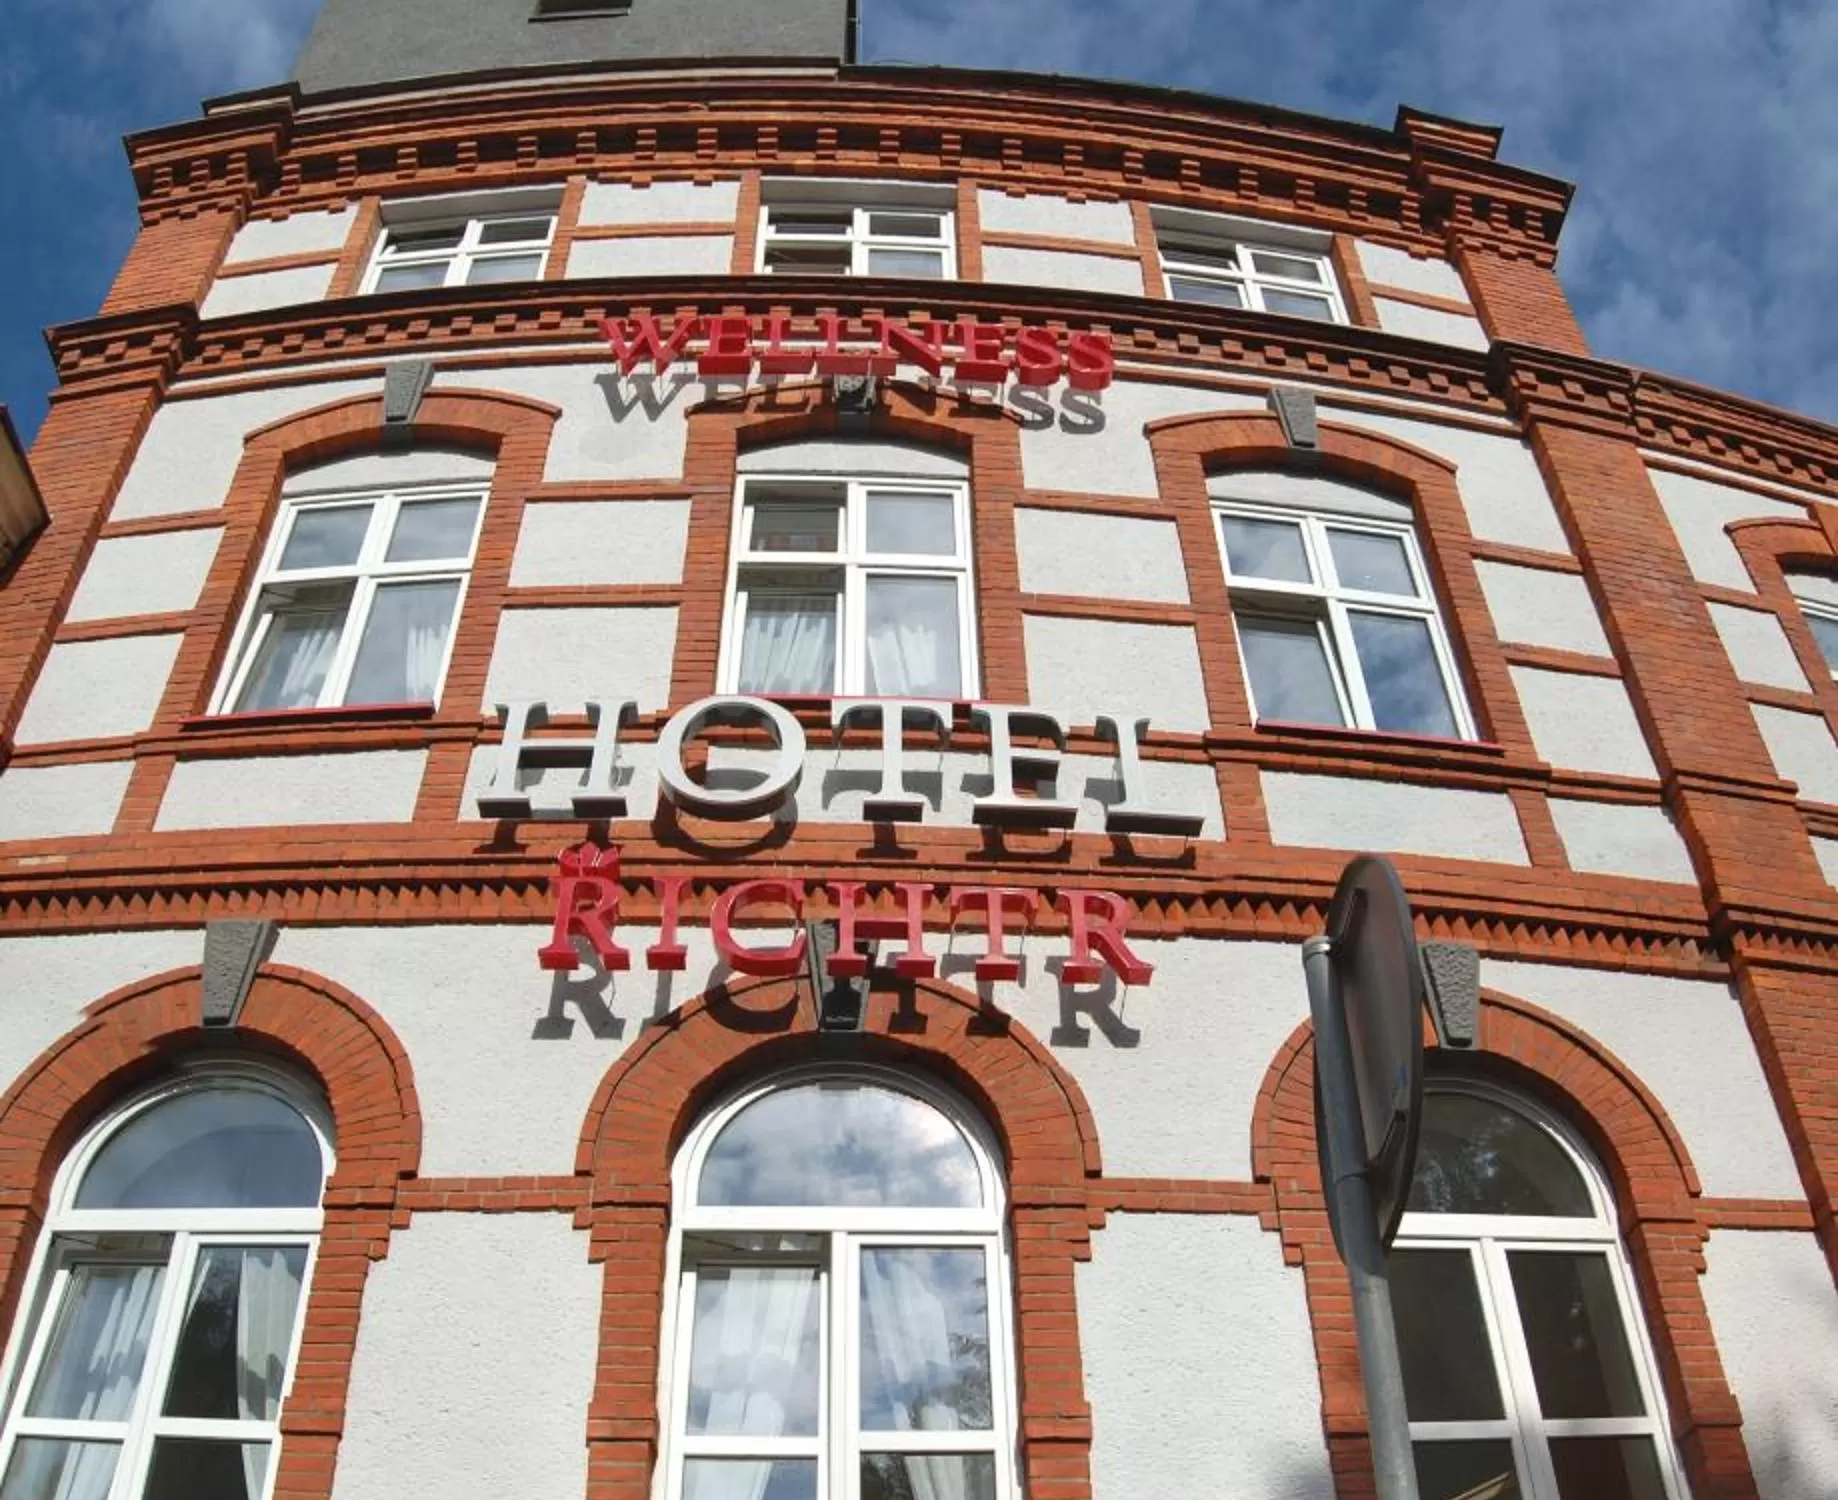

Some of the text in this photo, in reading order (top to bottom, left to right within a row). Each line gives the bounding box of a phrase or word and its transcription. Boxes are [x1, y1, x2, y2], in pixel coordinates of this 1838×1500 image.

[601, 315, 1114, 391] WELLNESS
[476, 694, 1204, 836] HOTEL
[538, 873, 1154, 985] RICHTR
